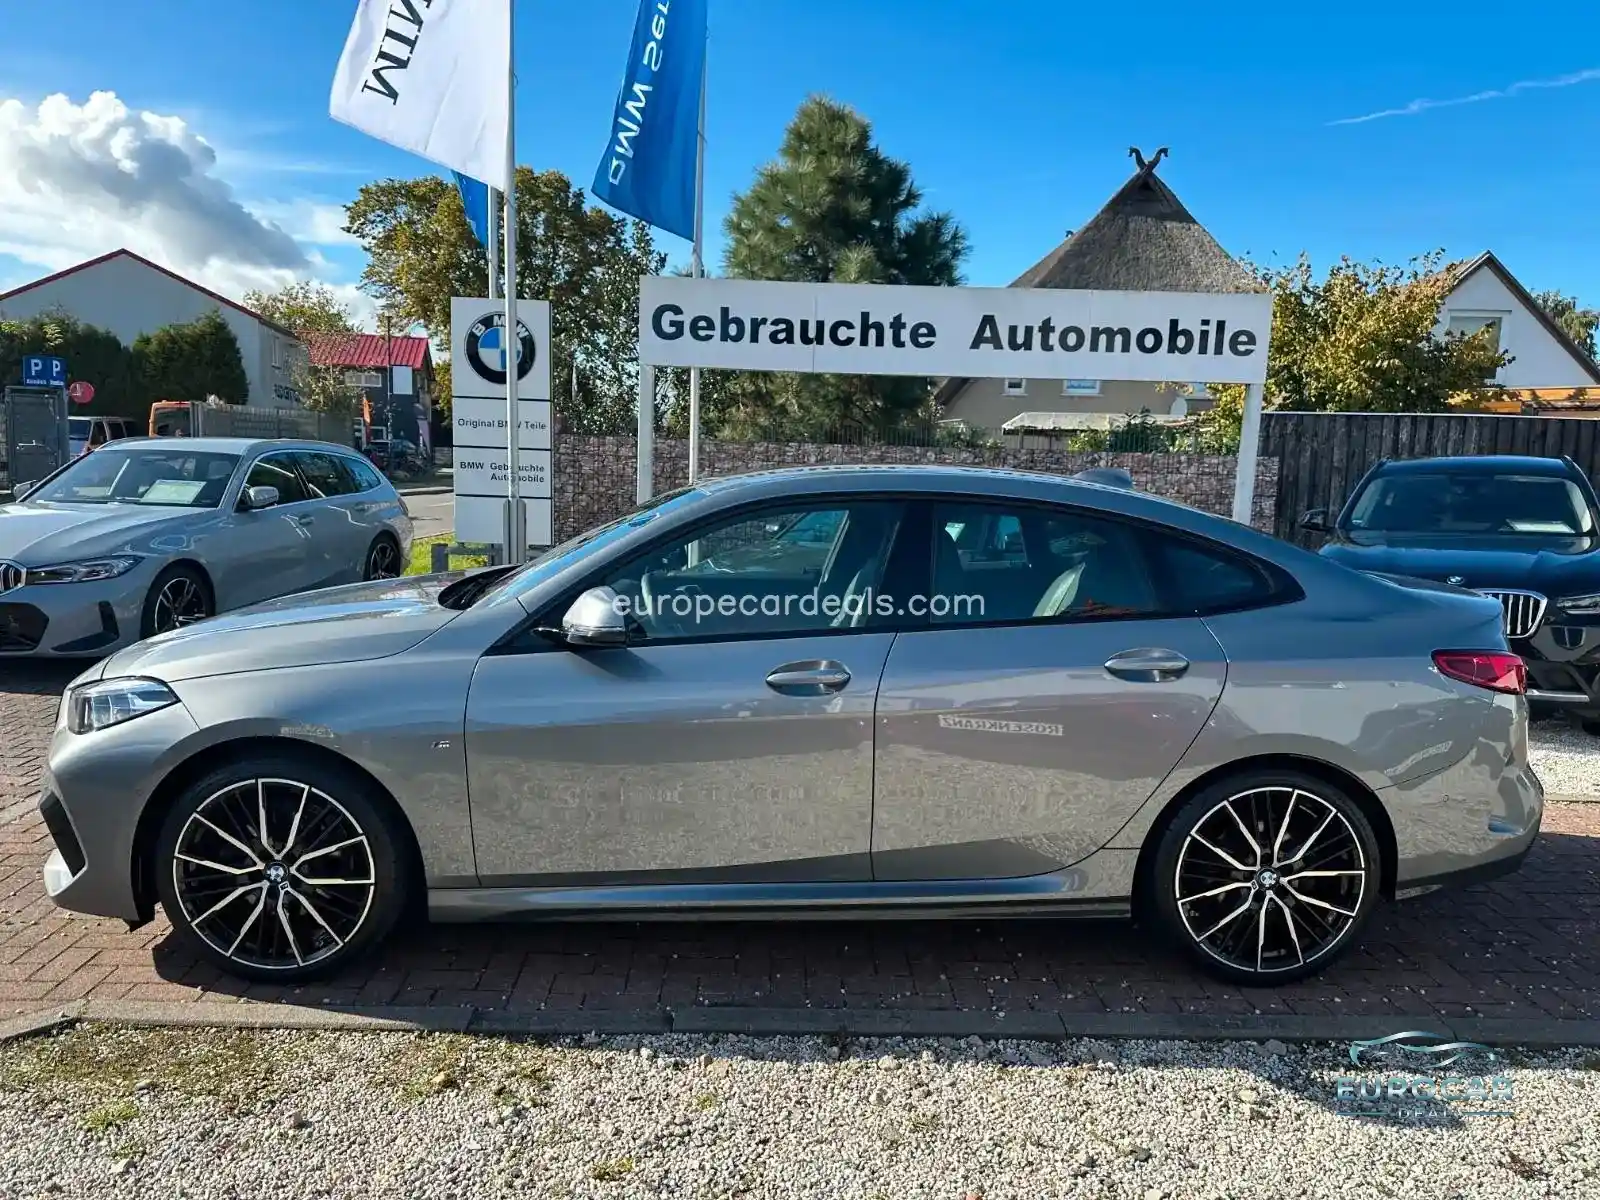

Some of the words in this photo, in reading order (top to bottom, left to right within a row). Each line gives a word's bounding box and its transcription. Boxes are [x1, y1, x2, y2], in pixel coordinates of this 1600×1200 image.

[470, 314, 531, 339] BMW
[651, 303, 938, 349] Gebrauchte
[969, 314, 1258, 357] Automobile
[30, 358, 43, 376] P
[52, 359, 61, 377] P
[457, 418, 495, 429] Original
[525, 421, 547, 430] Teile
[460, 461, 485, 470] BMW
[490, 462, 545, 473] Gebuchte
[490, 472, 545, 483] Autobile
